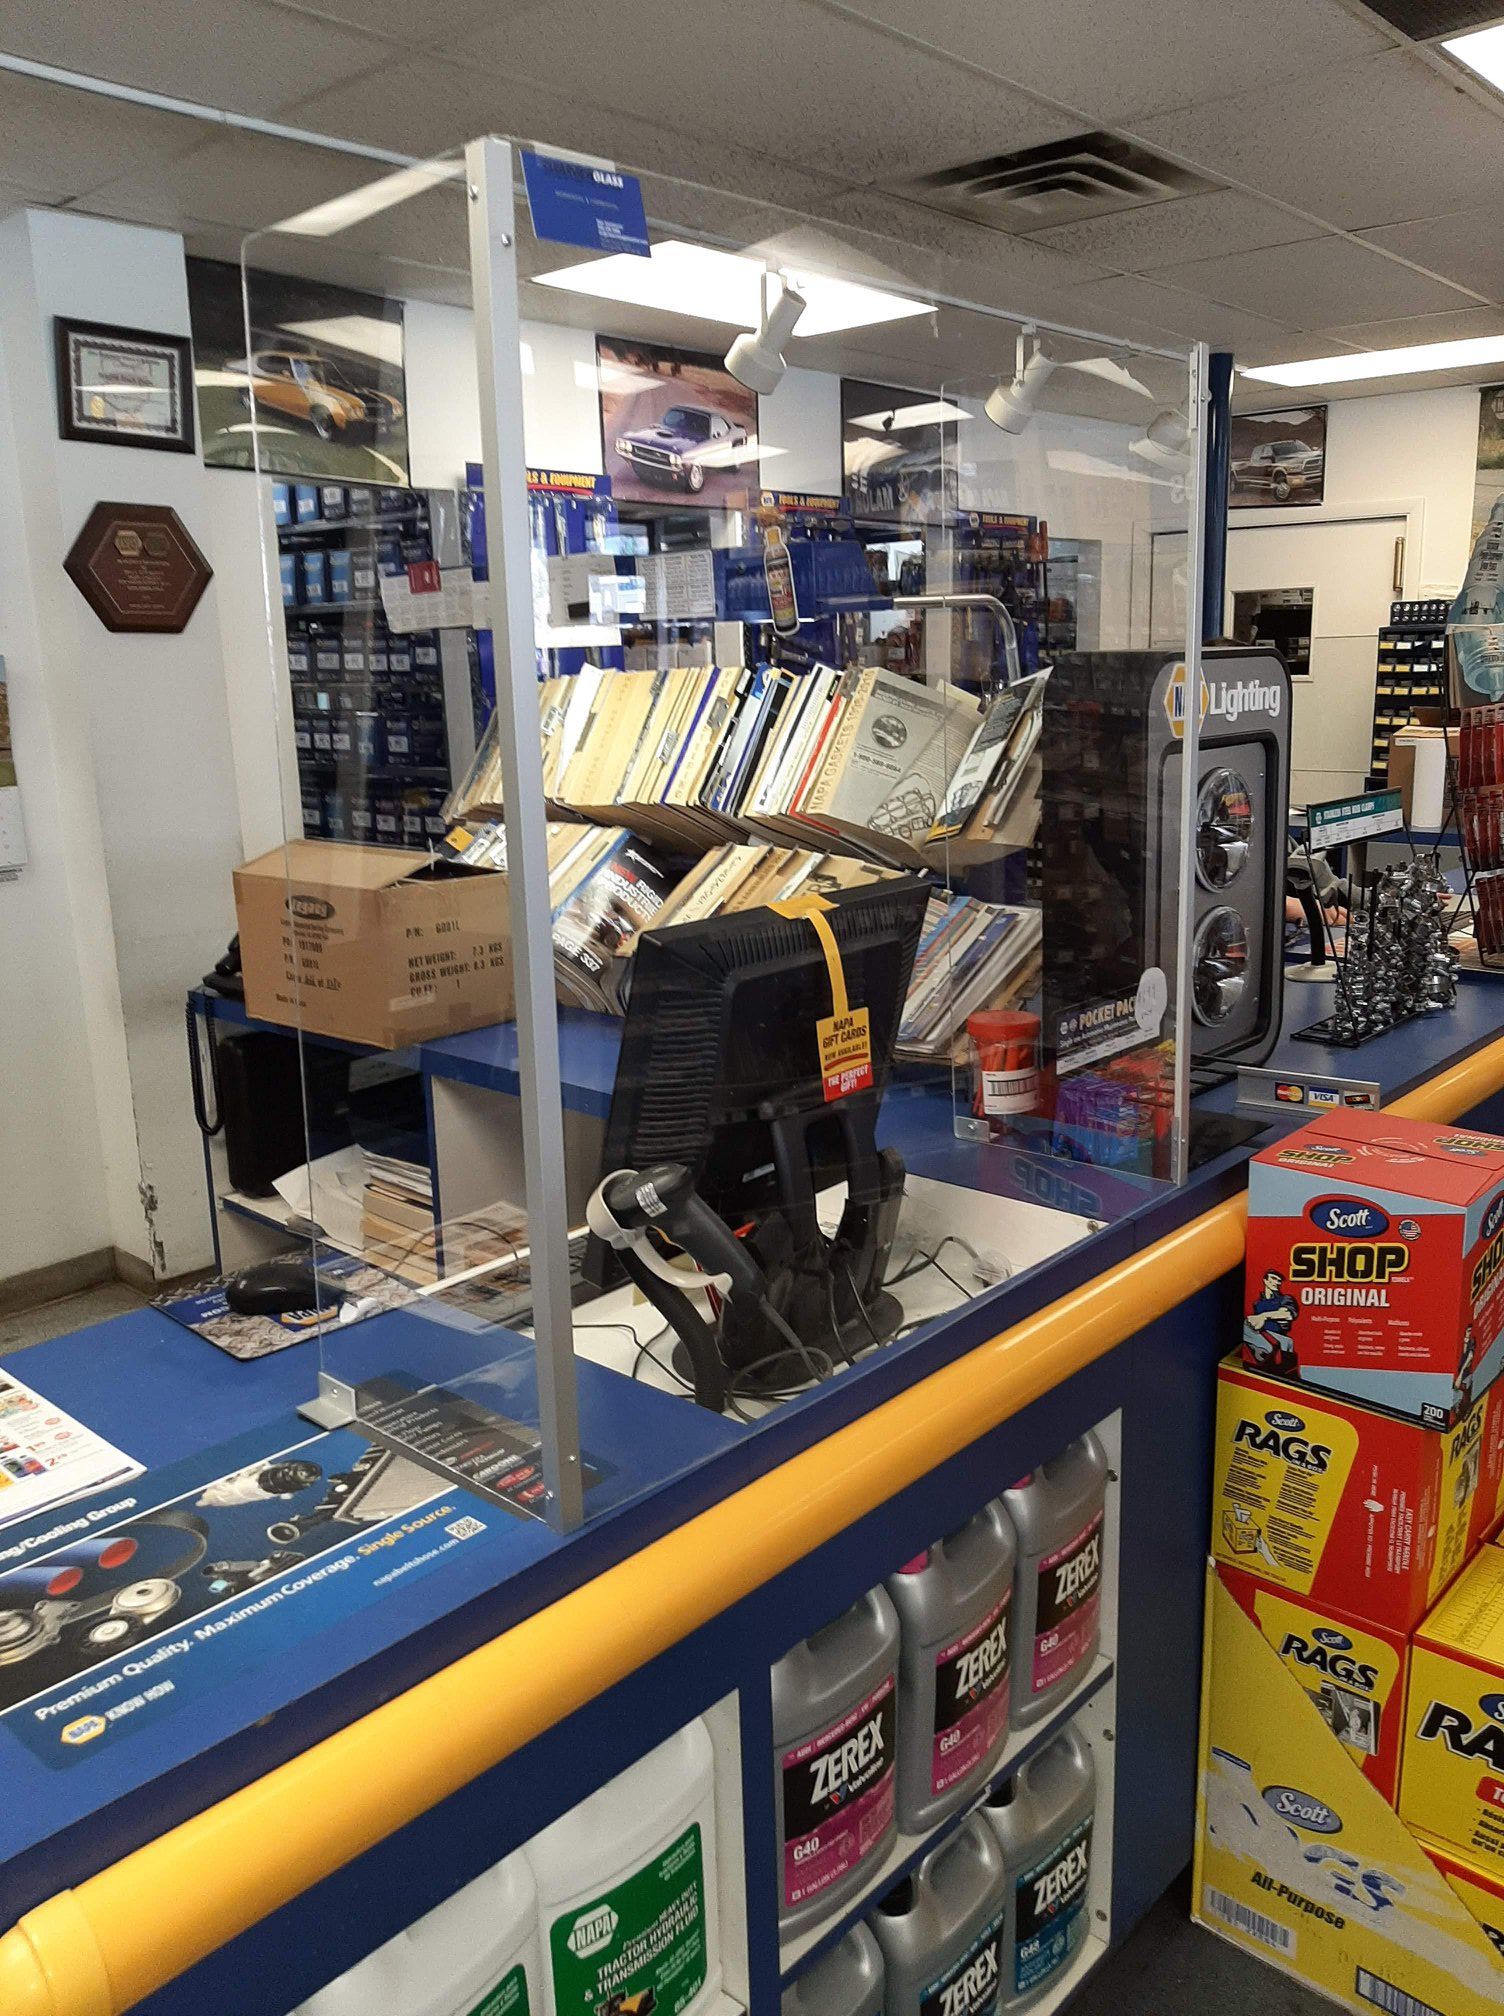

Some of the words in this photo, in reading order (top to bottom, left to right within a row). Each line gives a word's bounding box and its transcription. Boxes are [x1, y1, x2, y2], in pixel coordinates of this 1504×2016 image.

[550, 472, 596, 489] EQUIPMENT
[1210, 680, 1281, 721] Lighting
[635, 879, 664, 908] RIGID
[833, 1017, 854, 1032] NAPA
[1079, 1004, 1115, 1031] POCKET
[1116, 996, 1137, 1017] PAC
[823, 1034, 839, 1049] GIFT
[841, 1025, 867, 1042] CARDS
[1314, 1092, 1334, 1102] VISA
[1277, 1149, 1356, 1164] SHOP
[1325, 1208, 1370, 1230] Scott
[1289, 1242, 1409, 1283] SHOP
[1471, 1228, 1504, 1303] SHO
[1301, 1287, 1390, 1308] ORIGINAL
[1271, 1413, 1300, 1427] Scott
[1423, 1405, 1443, 1419] 200
[1234, 1418, 1332, 1470] RAGS
[86, 1497, 138, 1522] Group
[1054, 1533, 1099, 1605] ZEREX
[35, 1672, 122, 1721] Premium
[122, 1638, 194, 1677] Quality.
[194, 1593, 285, 1641] Maximum
[281, 1554, 360, 1595] Coverage.
[357, 1527, 406, 1557] Single
[402, 1504, 457, 1535] Source.
[1319, 1632, 1344, 1644] Scott
[955, 1617, 1007, 1699] ZEREX
[1280, 1632, 1379, 1691] RAGS
[940, 1729, 960, 1752] G40
[1416, 1700, 1504, 1773] RA
[809, 1712, 884, 1805] ZEREX
[1276, 1792, 1331, 1825] Scott
[793, 1837, 819, 1860] G40
[1033, 1839, 1088, 1915] ZEREX
[1251, 1870, 1346, 1930] All-Purpose
[575, 1912, 613, 1951] NAPA
[597, 1936, 647, 1980] TRACTOR
[649, 1890, 698, 1946] HYDRAULIC
[597, 1930, 674, 1995] TRANSMISSION
[675, 1904, 699, 1937] FLUID
[584, 1989, 593, 2001] &
[939, 1941, 998, 2016] ZEREX
